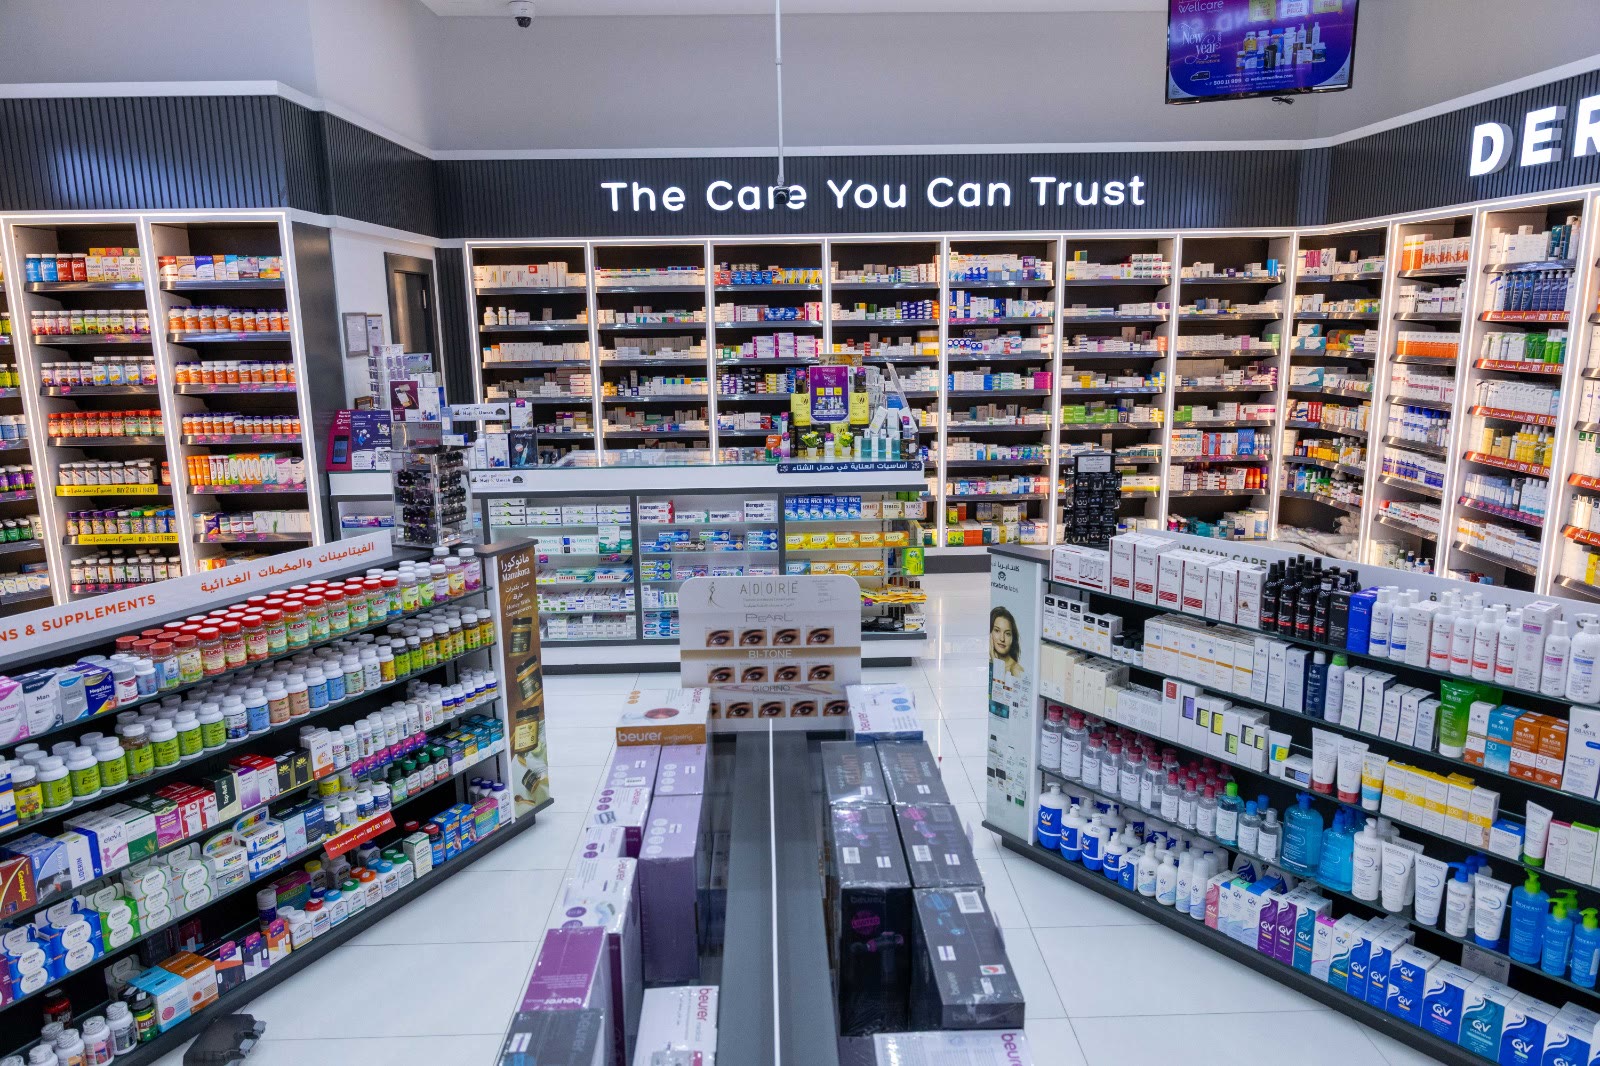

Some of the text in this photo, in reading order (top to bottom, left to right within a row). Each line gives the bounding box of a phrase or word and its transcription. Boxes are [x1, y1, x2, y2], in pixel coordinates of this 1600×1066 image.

[1182, 30, 1203, 46] New
[1470, 94, 1600, 177] DER
[600, 175, 1146, 212] The Care You Can Trust
[876, 462, 908, 470] أساسيات
[201, 542, 374, 593] الفيتامينات والمكملات الغذائية
[25, 624, 35, 636] &
[42, 594, 156, 632] SUPPLEMENTS
[749, 650, 792, 659] BI-TONE
[858, 713, 871, 731] beurer
[618, 731, 662, 742] beurer
[1041, 812, 1053, 821] QV
[103, 831, 122, 844] elevit
[258, 830, 279, 843] Centrum
[223, 853, 242, 864] Centrum
[261, 850, 281, 862] Centrum
[1418, 858, 1444, 871] BIODERMA
[226, 871, 244, 881] Centrum
[1478, 879, 1505, 892] BIODERMA
[852, 915, 881, 928] LIMITED
[1260, 921, 1275, 933] QV
[66, 925, 85, 937] Centrum
[1278, 925, 1293, 936] QV
[1298, 931, 1311, 941] QV
[1318, 929, 1328, 938] QV
[1336, 936, 1346, 945] QV
[70, 945, 88, 956] Centrum
[1351, 962, 1366, 973] QV
[1401, 966, 1415, 977] QV
[1370, 971, 1386, 983] QV
[696, 987, 713, 1022] beurer
[1398, 995, 1412, 1006] QV
[1432, 1003, 1453, 1017] QV
[1471, 1019, 1492, 1033] QV
[1512, 1038, 1533, 1052] QV
